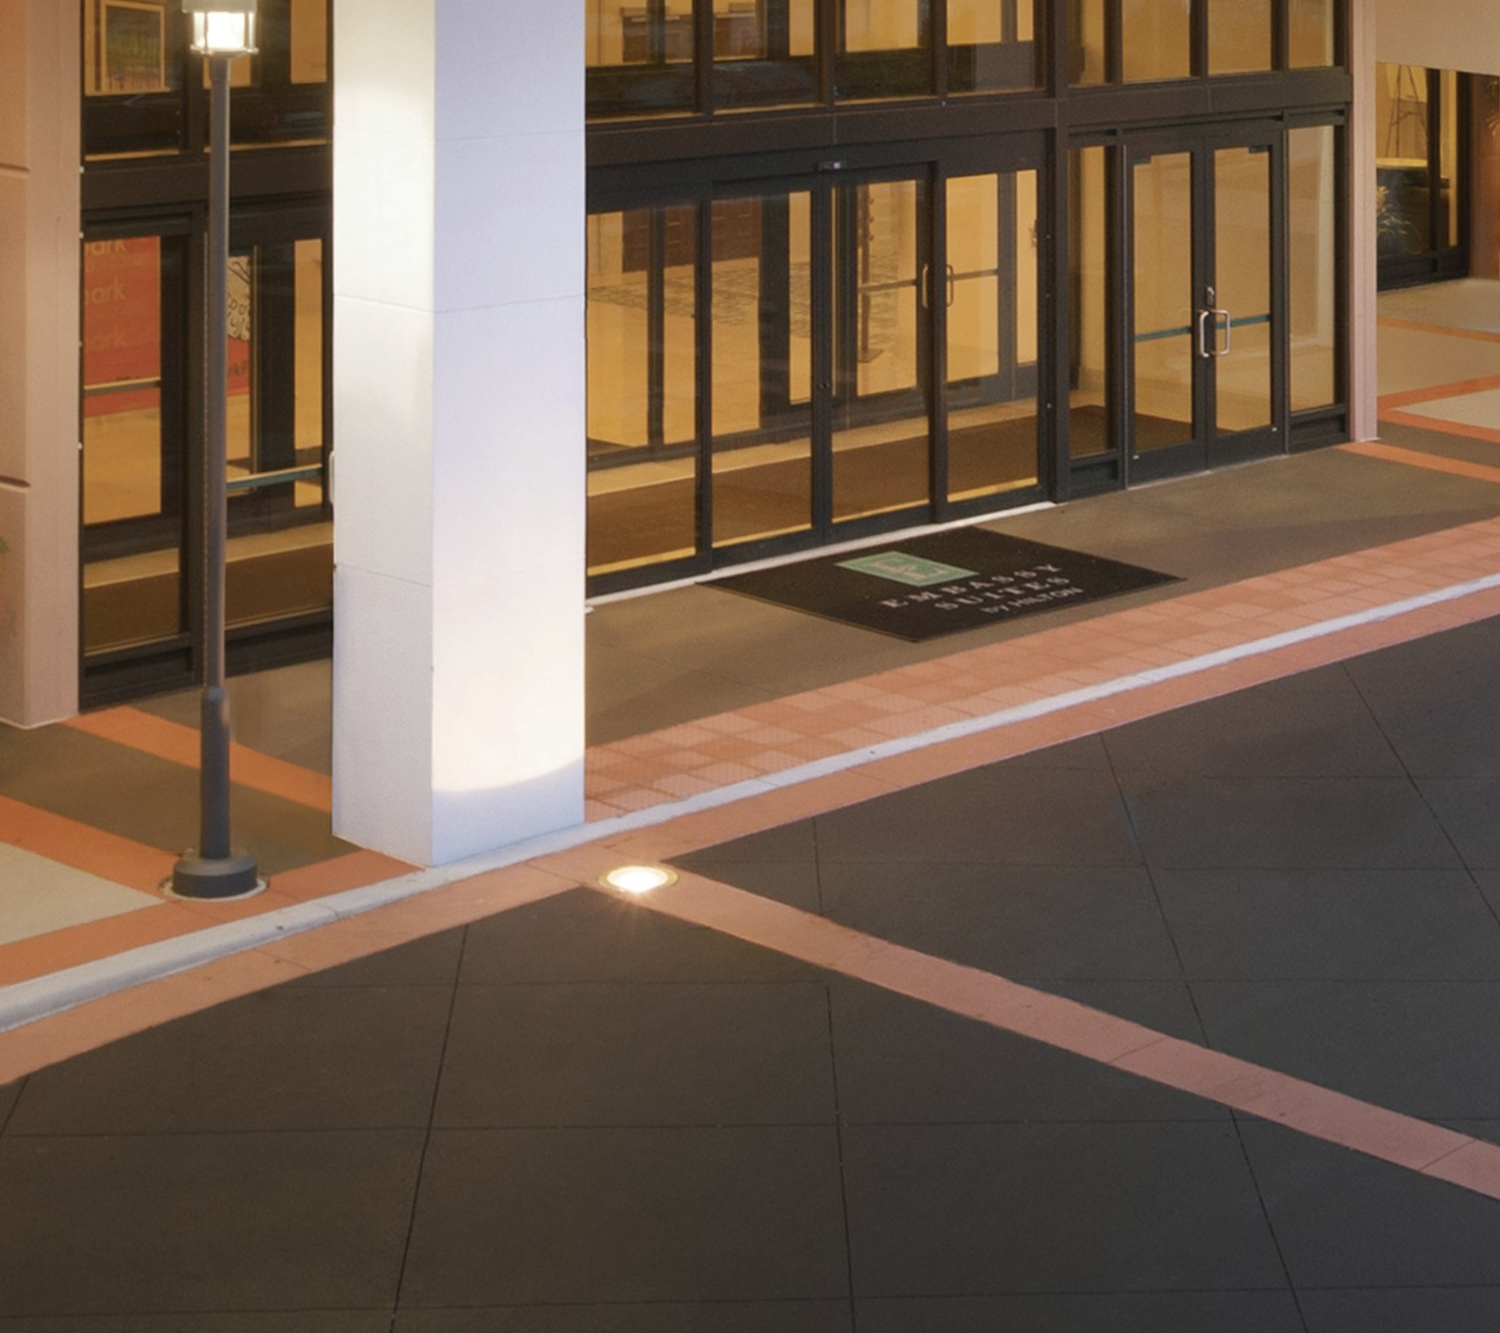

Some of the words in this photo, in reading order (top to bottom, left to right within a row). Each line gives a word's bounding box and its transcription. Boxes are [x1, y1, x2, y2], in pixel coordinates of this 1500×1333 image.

[85, 241, 126, 256] ark
[85, 277, 126, 305] ark
[880, 564, 1062, 608] EMBASSY
[934, 577, 1070, 611] SUITES
[1007, 587, 1084, 608] HILTON
